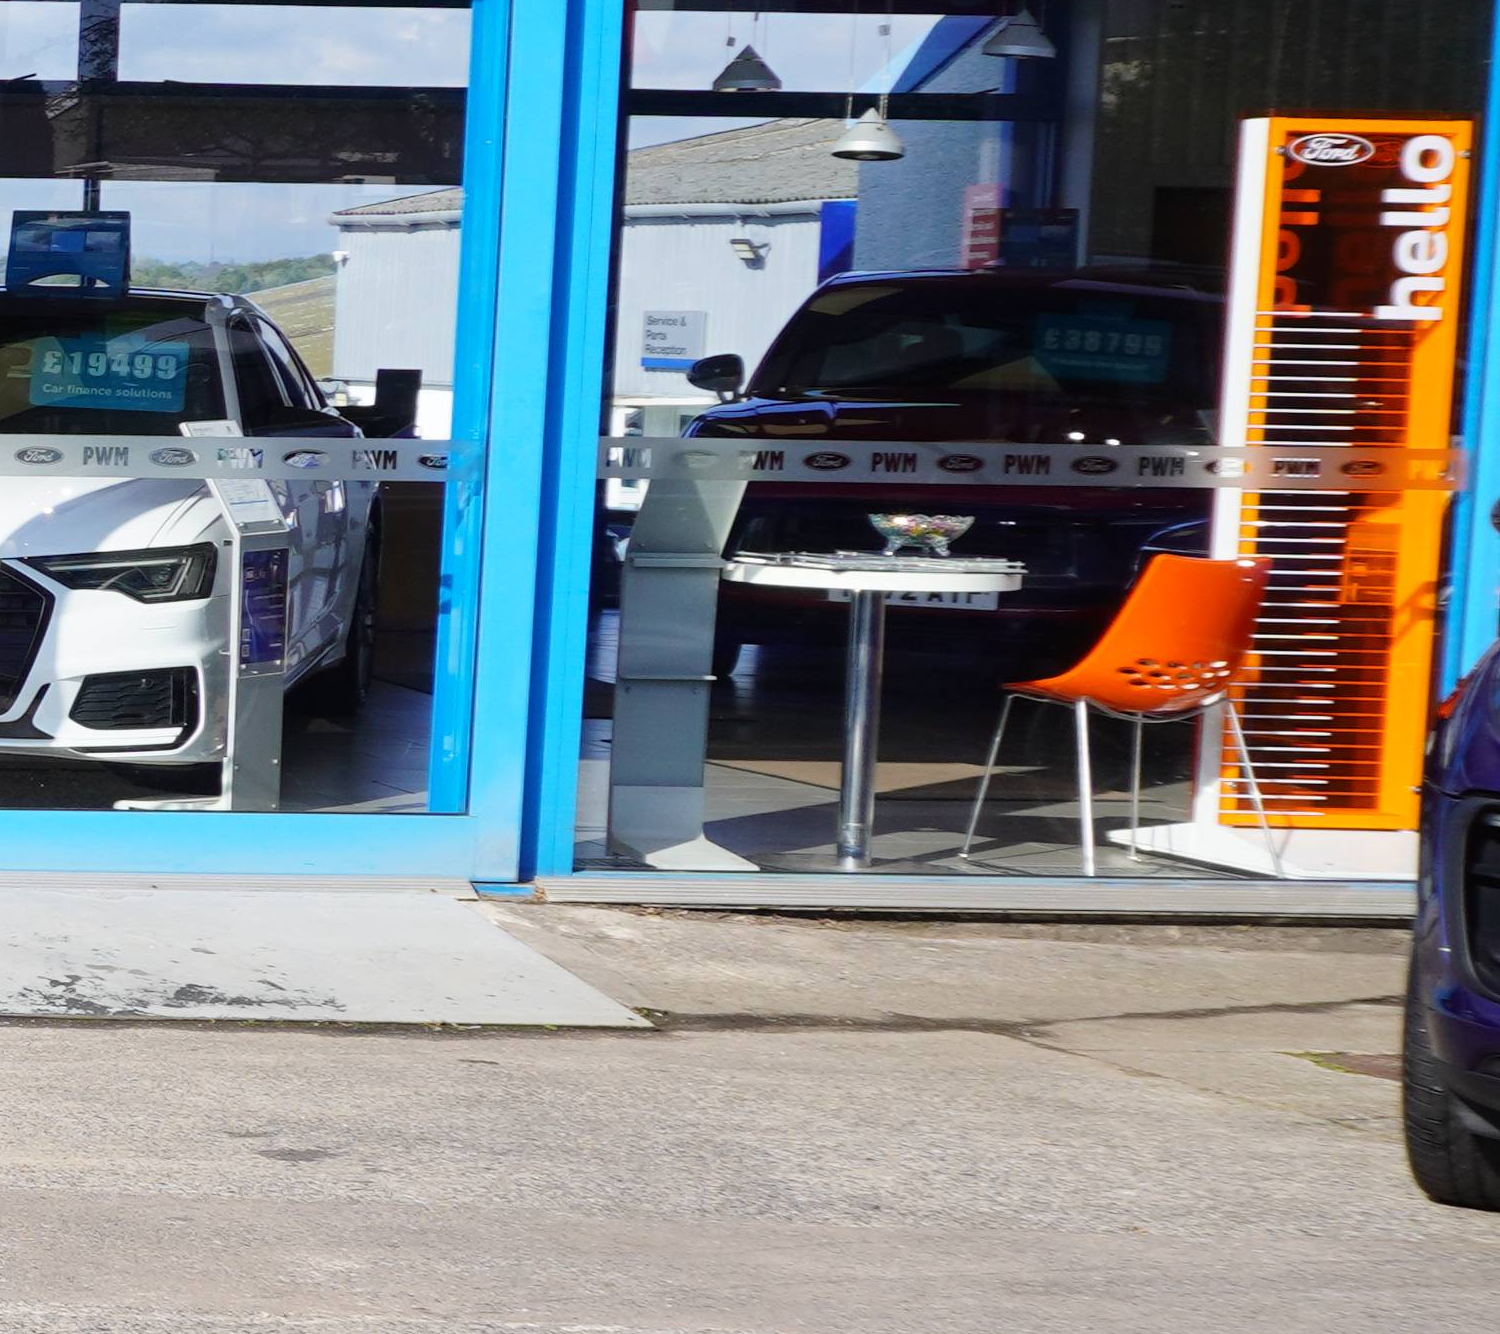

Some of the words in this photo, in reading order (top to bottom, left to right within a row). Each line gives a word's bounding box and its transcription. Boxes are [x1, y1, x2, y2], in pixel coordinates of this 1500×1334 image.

[1296, 135, 1367, 164] Ford
[1373, 135, 1455, 320] hello
[42, 350, 178, 380] £19499
[42, 383, 64, 394] Car
[67, 384, 113, 396] finance
[115, 387, 173, 399] solutions
[19, 448, 59, 465] Ford
[82, 446, 129, 468] PWM
[153, 449, 193, 466] Ford
[871, 451, 917, 473] PWM
[1004, 454, 1050, 475] PWM
[1138, 456, 1185, 477] PWM
